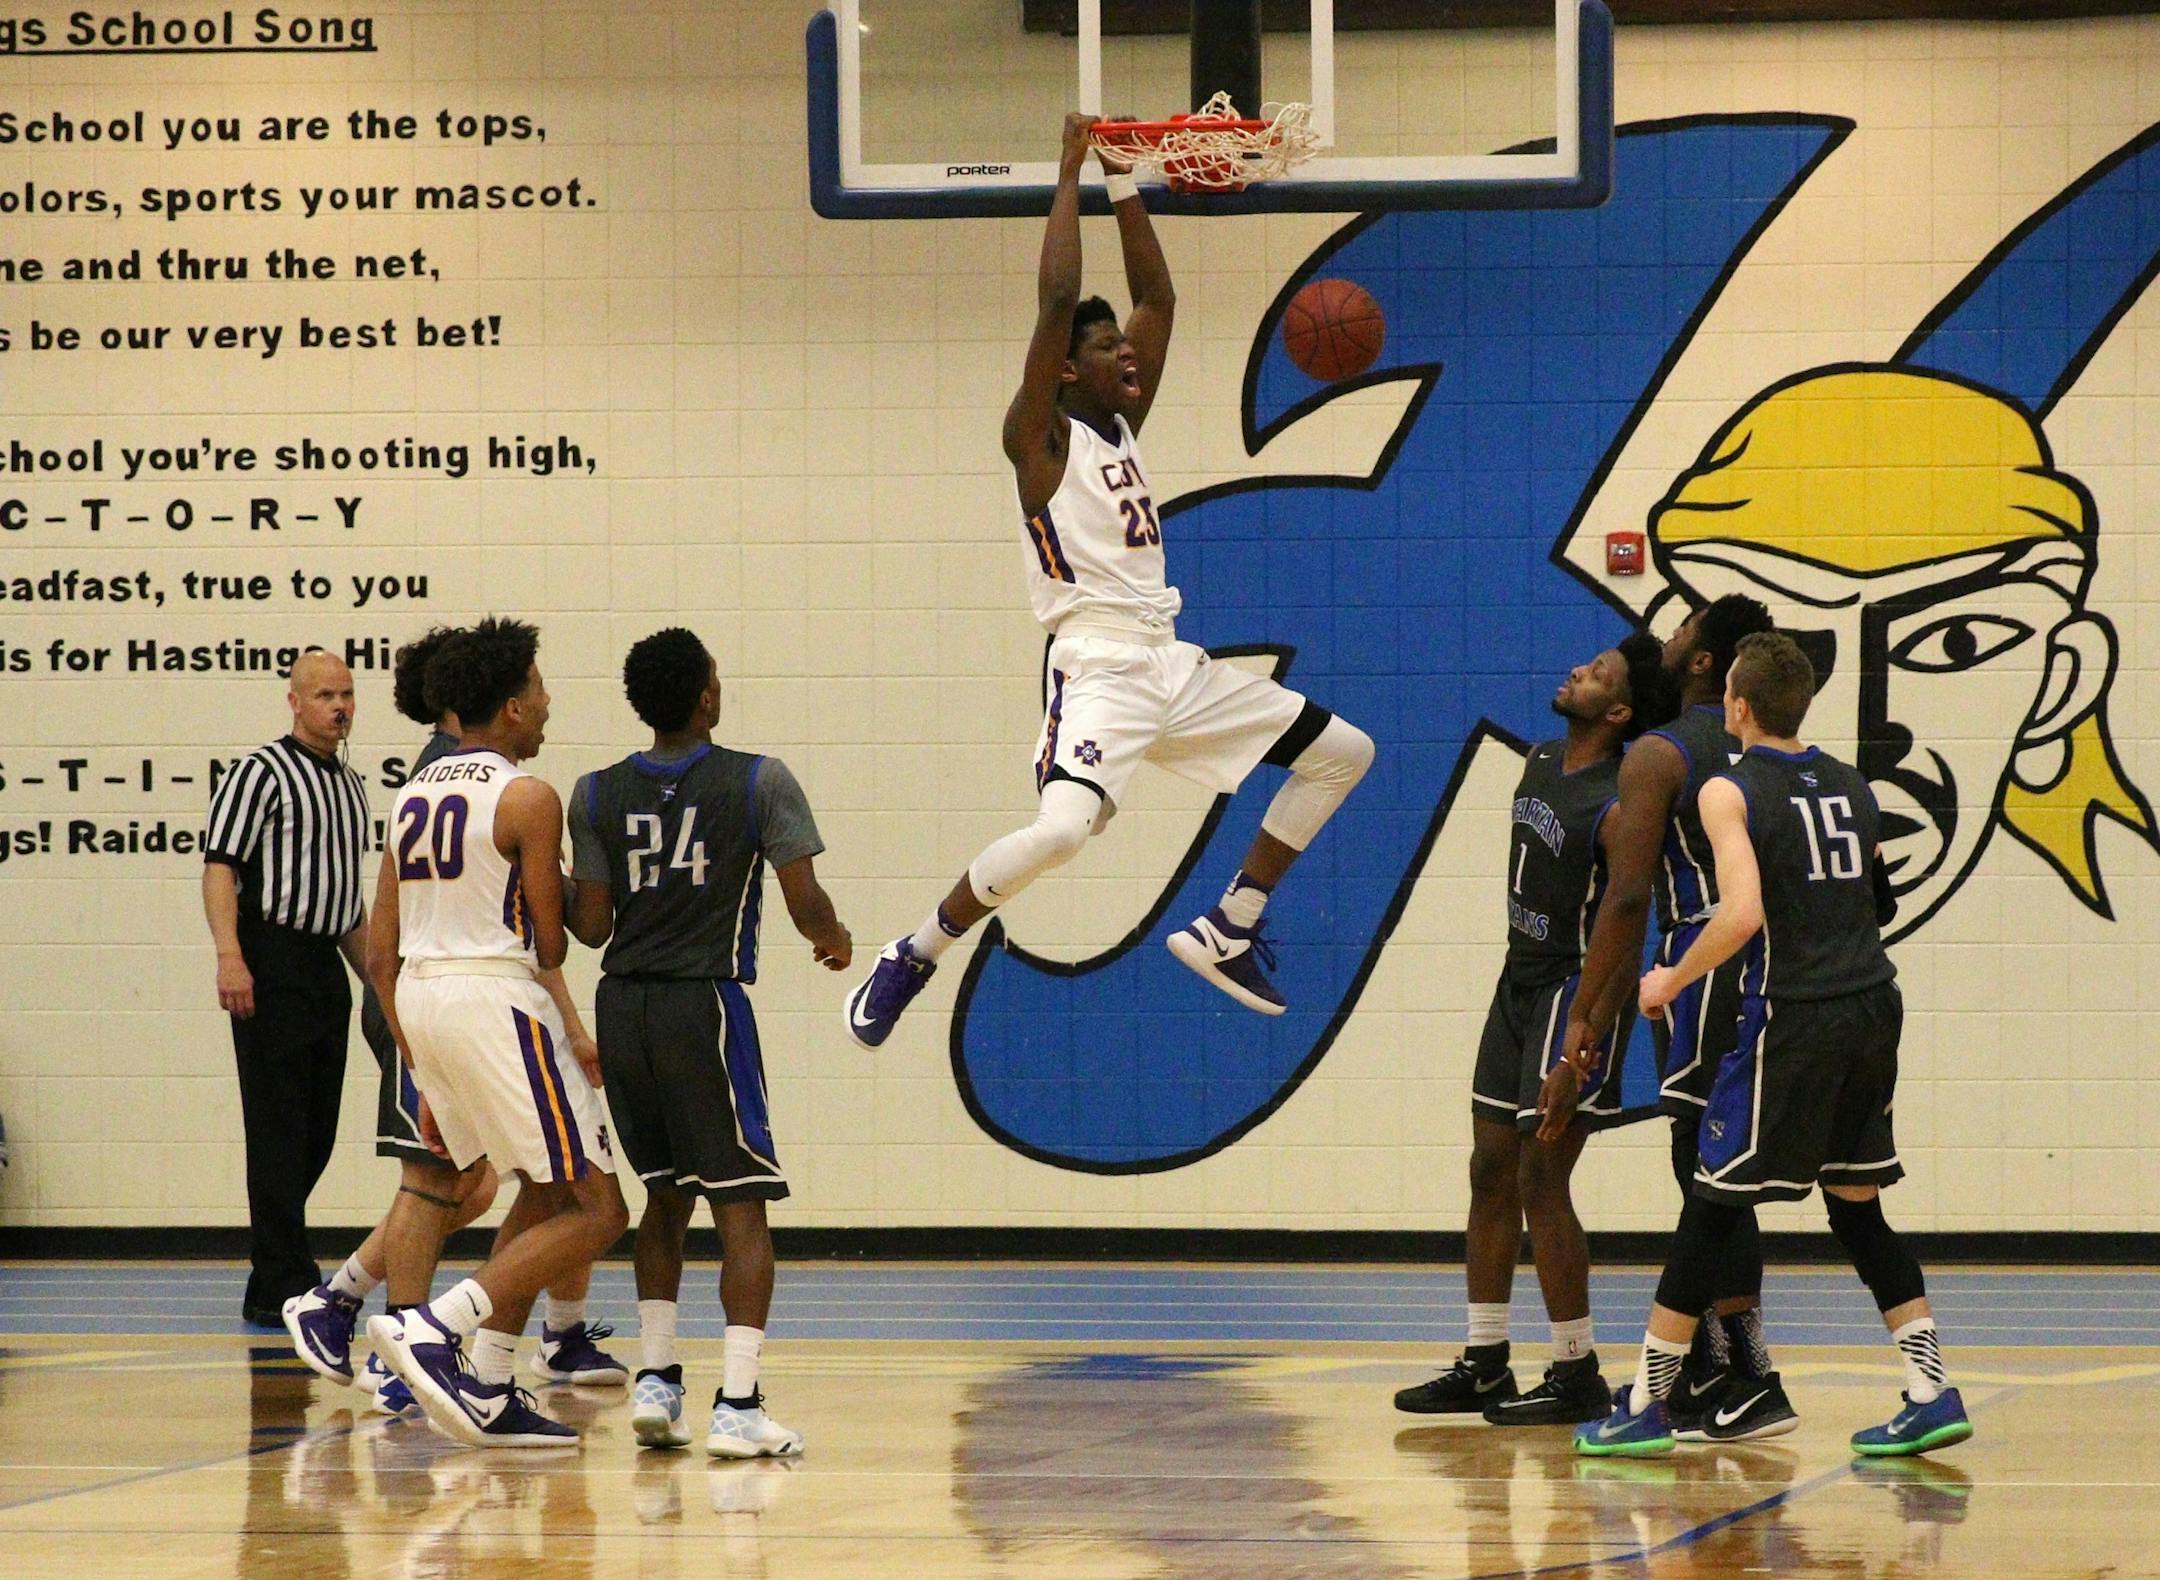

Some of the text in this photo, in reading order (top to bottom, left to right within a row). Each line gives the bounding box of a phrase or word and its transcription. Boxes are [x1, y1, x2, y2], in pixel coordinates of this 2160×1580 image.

[66, 10, 233, 47] School
[254, 8, 374, 50] Song
[0, 108, 546, 150] School you are the tops,
[0, 178, 596, 221] olors, sports your mascot.
[62, 250, 141, 281] and
[156, 249, 248, 281] thru
[265, 249, 335, 280] the
[355, 249, 439, 282] net,
[31, 321, 81, 351] be
[100, 327, 171, 350] our
[187, 326, 283, 360] very
[300, 318, 397, 349] best
[416, 316, 501, 348] bet!
[0, 436, 597, 481] hool you're shooting high,
[0, 569, 428, 608] adfast, true to you
[46, 639, 111, 671] for
[127, 639, 323, 679] Hasting
[407, 762, 496, 787] AIDERS
[397, 793, 468, 881] 20
[626, 806, 711, 893] 24
[1789, 795, 1863, 881] 15
[1513, 842, 1528, 895] 1
